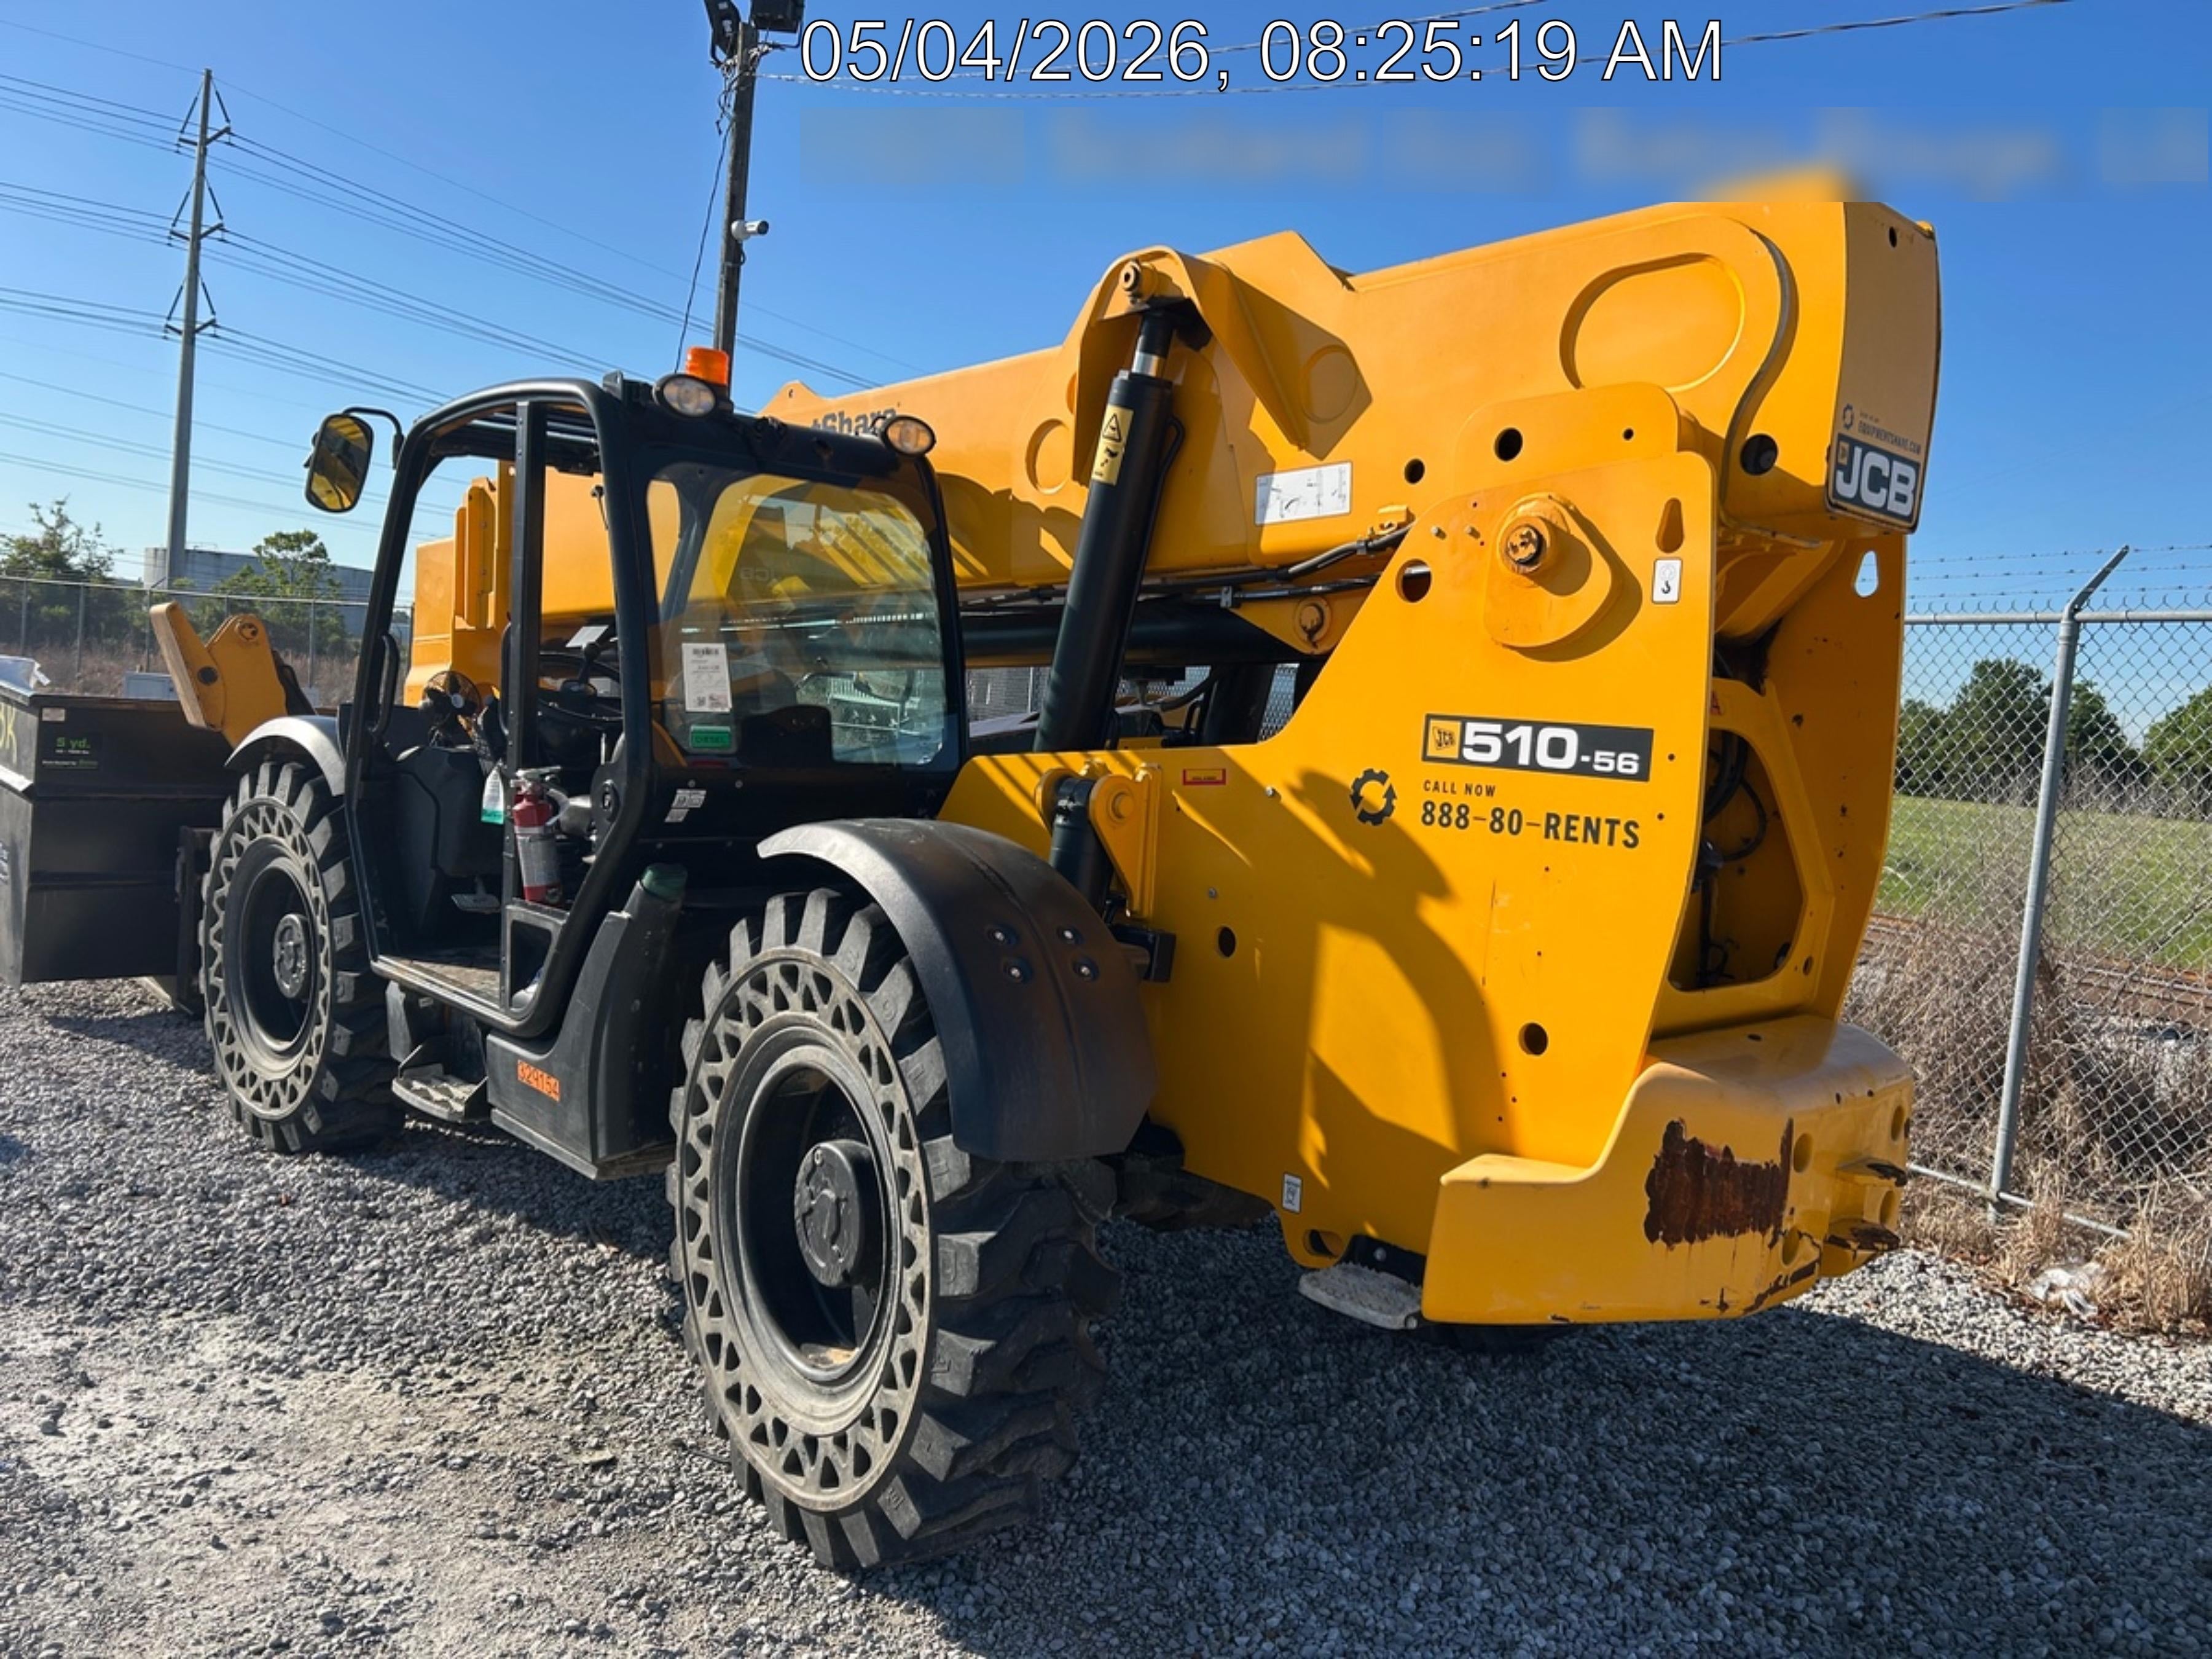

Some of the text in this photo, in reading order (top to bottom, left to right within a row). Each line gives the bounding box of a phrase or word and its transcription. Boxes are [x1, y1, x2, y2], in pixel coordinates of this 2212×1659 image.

[1835, 447, 1916, 517] JCB
[1462, 721, 1641, 775] 510-56
[1423, 780, 1497, 798] CALL NOW
[1421, 800, 1640, 850] 888-80-RENTS
